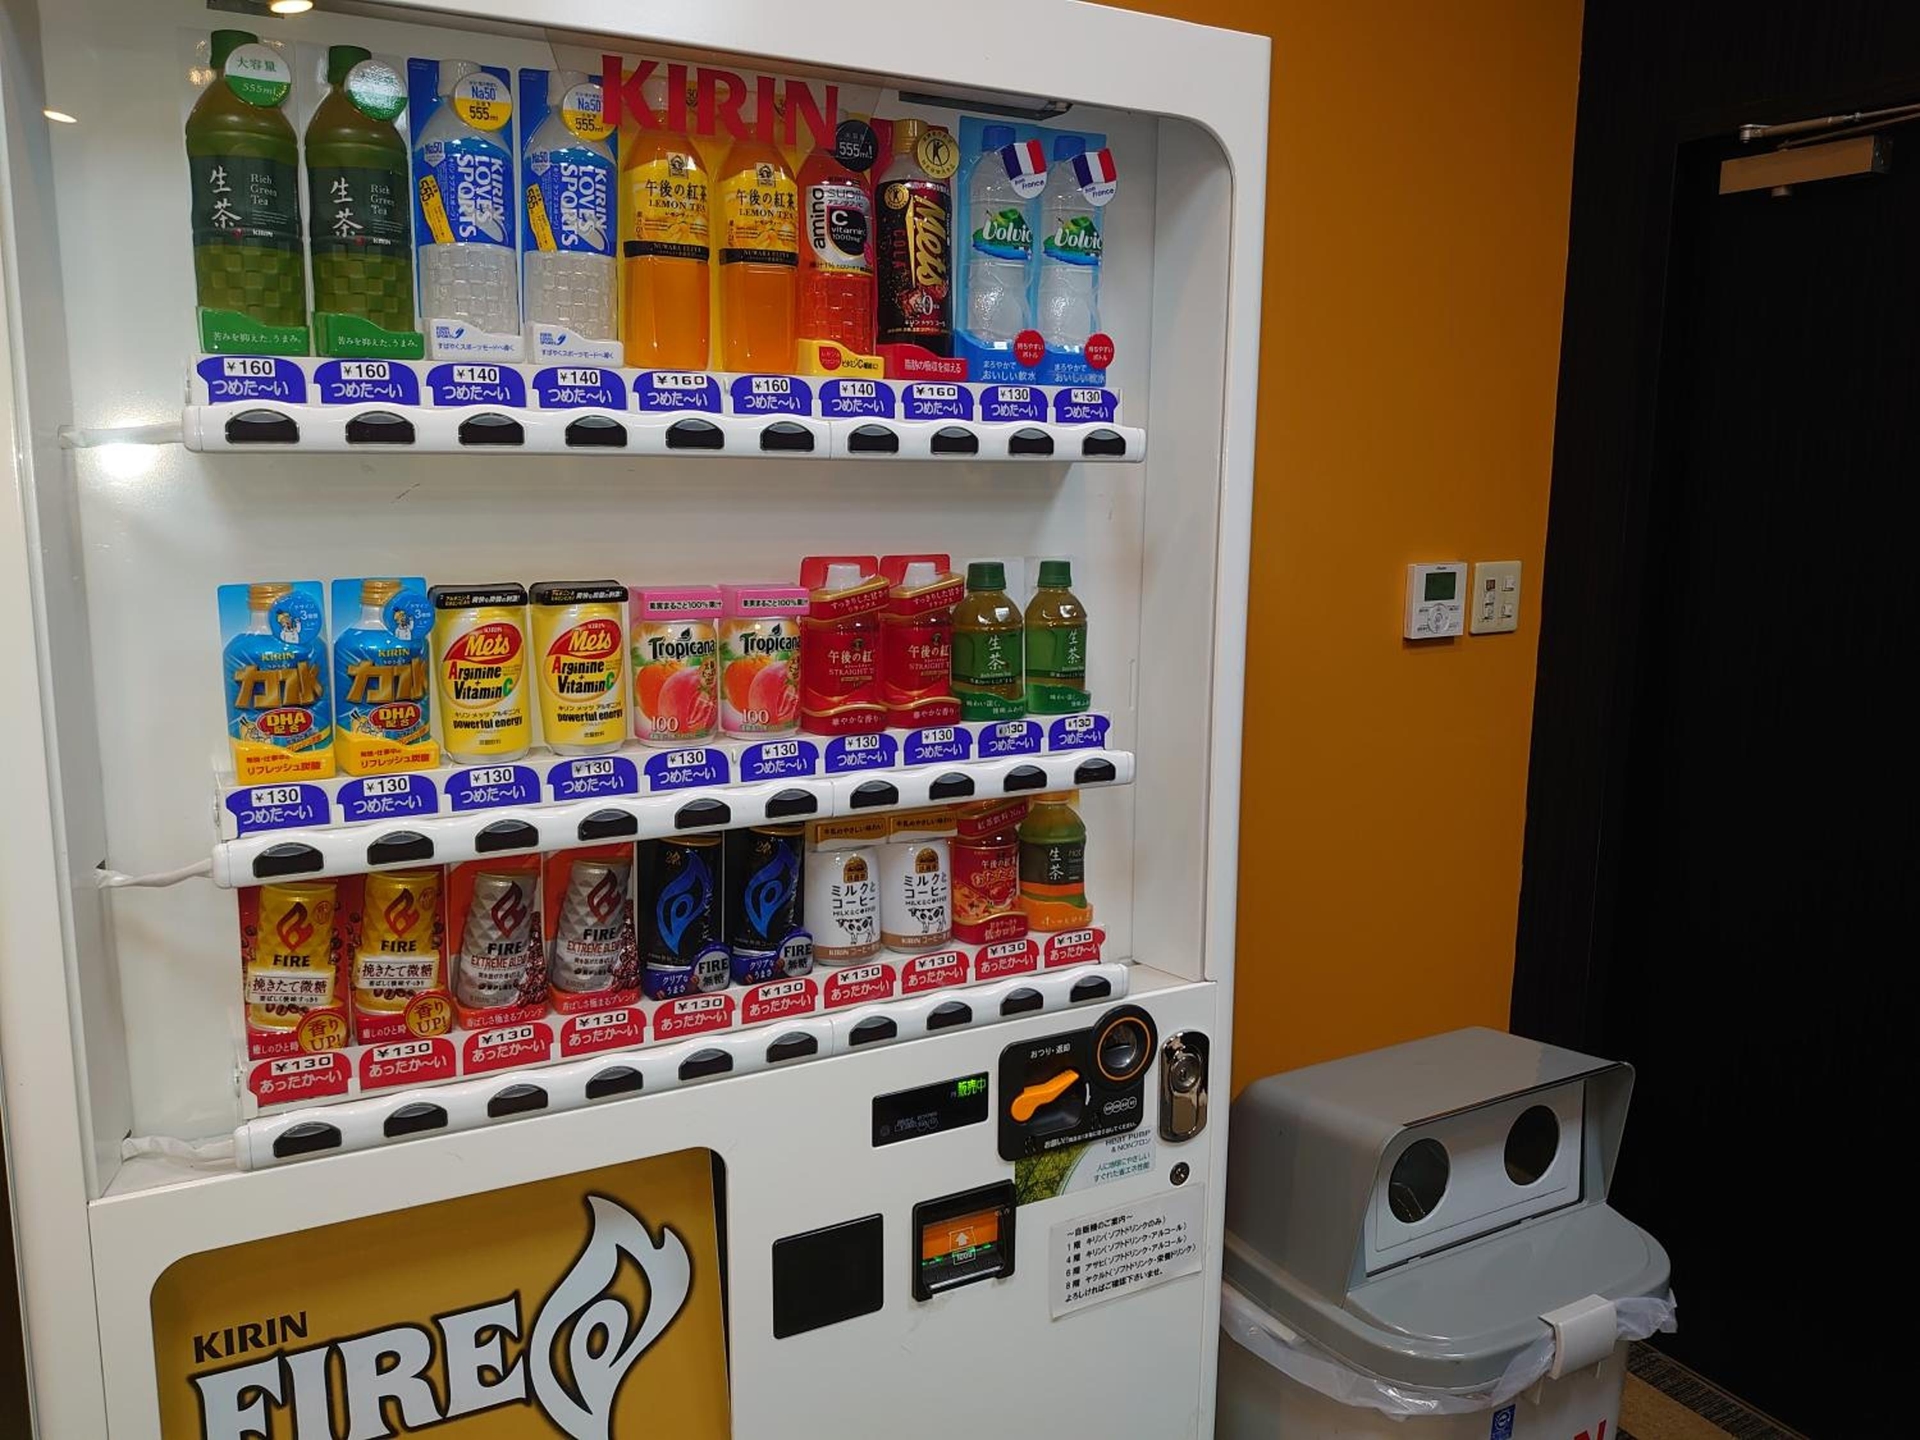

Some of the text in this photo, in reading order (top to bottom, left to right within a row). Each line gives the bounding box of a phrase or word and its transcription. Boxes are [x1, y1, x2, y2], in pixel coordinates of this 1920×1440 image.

[237, 56, 278, 74] 大容量
[472, 86, 496, 100] Na50
[578, 99, 601, 112] Na50
[603, 55, 838, 151] KIRIN
[251, 174, 272, 184] Rich
[1022, 180, 1045, 189] France
[251, 184, 277, 197] Green
[370, 184, 391, 195] Rich
[457, 153, 477, 238] SPORTS
[474, 155, 493, 223] LOVES
[490, 157, 505, 222] KIRIN
[645, 179, 707, 202] 午後の紅茶
[1092, 188, 1115, 197] France
[209, 165, 242, 228] 生茶
[251, 195, 269, 206] Tea
[370, 194, 395, 205] Green
[578, 165, 596, 233] LOVES
[594, 167, 607, 230] KIRIN
[736, 189, 795, 210] 午後の紅茶
[330, 177, 364, 238] 生茶
[371, 204, 387, 215] Tea
[560, 163, 578, 246] SPORTS
[649, 200, 706, 212] LEMON TEA
[739, 209, 794, 219] LEMON TEA
[810, 188, 826, 249] amino
[831, 210, 848, 226] C
[983, 219, 1032, 242] Volvic
[914, 195, 946, 286] Mets
[1055, 228, 1102, 249] Volvic
[213, 331, 302, 344] 苦みを抑えた、うまみ。
[337, 335, 419, 348] 苦みを抑えた、うまみ。
[226, 359, 273, 376] ¥160
[343, 363, 388, 378] ¥160
[456, 368, 498, 383] ¥140
[560, 371, 599, 385] ¥140
[656, 375, 705, 386] ¥160
[754, 379, 789, 393] ¥160
[842, 384, 874, 395] ¥140
[916, 387, 956, 397] ¥160
[1000, 389, 1029, 400] ¥130
[1074, 392, 1100, 402] ¥130
[465, 633, 511, 656] Mets
[567, 629, 612, 651] Mets
[740, 632, 800, 655] Tropicana
[1067, 630, 1081, 664] 生茶
[378, 648, 410, 659] KIRIN
[648, 636, 715, 660] Tropicana
[988, 634, 1005, 671] 生茶
[261, 651, 295, 661] KIRIN
[448, 661, 501, 680] Arginine
[551, 656, 604, 675] Arginine
[829, 668, 867, 677] STRAIGHT
[909, 662, 945, 670] STRAIGHT
[266, 711, 307, 726] DHA
[378, 708, 415, 721] DHA
[558, 709, 623, 722] powerful energy
[743, 709, 769, 723] 100
[385, 718, 410, 728] 配合
[453, 715, 522, 729] powerful energy
[651, 716, 679, 731] 100
[274, 724, 299, 735] 配合
[924, 729, 953, 741] ¥130
[847, 735, 878, 748] ¥130
[764, 743, 797, 756] ¥130
[360, 753, 430, 769] リフレッシュ炭酸
[670, 751, 704, 764] ¥130
[247, 760, 321, 776] リフレッシュ炭酸
[574, 761, 611, 774] ¥130
[473, 769, 512, 783] ¥130
[366, 777, 408, 794] ¥130
[255, 788, 299, 804] ¥130
[1049, 847, 1064, 881] 生茶
[904, 871, 947, 887] ミルクと
[832, 881, 876, 897] ミルクと
[904, 886, 947, 899] コーヒー
[832, 896, 876, 909] コーヒー
[584, 927, 617, 940] FIRE
[985, 926, 1025, 941] 低カロリー
[1056, 932, 1091, 945] ¥130
[381, 940, 417, 952] FIRE
[487, 942, 523, 955] FIRE
[784, 943, 812, 957] FIRE
[990, 942, 1026, 955] ¥130
[273, 955, 311, 967] FIRE
[698, 957, 728, 974] FIRE
[750, 959, 774, 971] クリアな
[788, 957, 808, 970] 無糖
[918, 955, 956, 968] ¥130
[362, 963, 433, 978] 挽きたて微糖
[754, 969, 773, 980] うまさ
[840, 967, 881, 982] ¥130
[252, 978, 327, 994] 挽きたて微糖
[663, 975, 688, 987] クリアな
[702, 975, 725, 986] 無糖
[666, 984, 686, 995] うまさ
[761, 983, 803, 997] ¥130
[562, 992, 637, 1011] 香ばしさ極まるブレンド
[677, 998, 723, 1010] ¥130
[415, 1001, 444, 1019] 香り
[416, 1017, 447, 1033] UP!
[466, 1008, 544, 1028] 香ばしさ極まるブレンド
[579, 1013, 627, 1027] ¥130
[308, 1018, 339, 1037] 香り
[310, 1034, 341, 1051] UP!
[481, 1028, 532, 1044] ¥130
[376, 1043, 431, 1058] ¥130
[1029, 1042, 1072, 1059] おつり・返却
[274, 1057, 331, 1072] ¥130
[1094, 1162, 1150, 1182] すぐれた省エネ性能
[193, 1311, 308, 1364] KIRIN
[191, 1292, 533, 1440] FIRE
